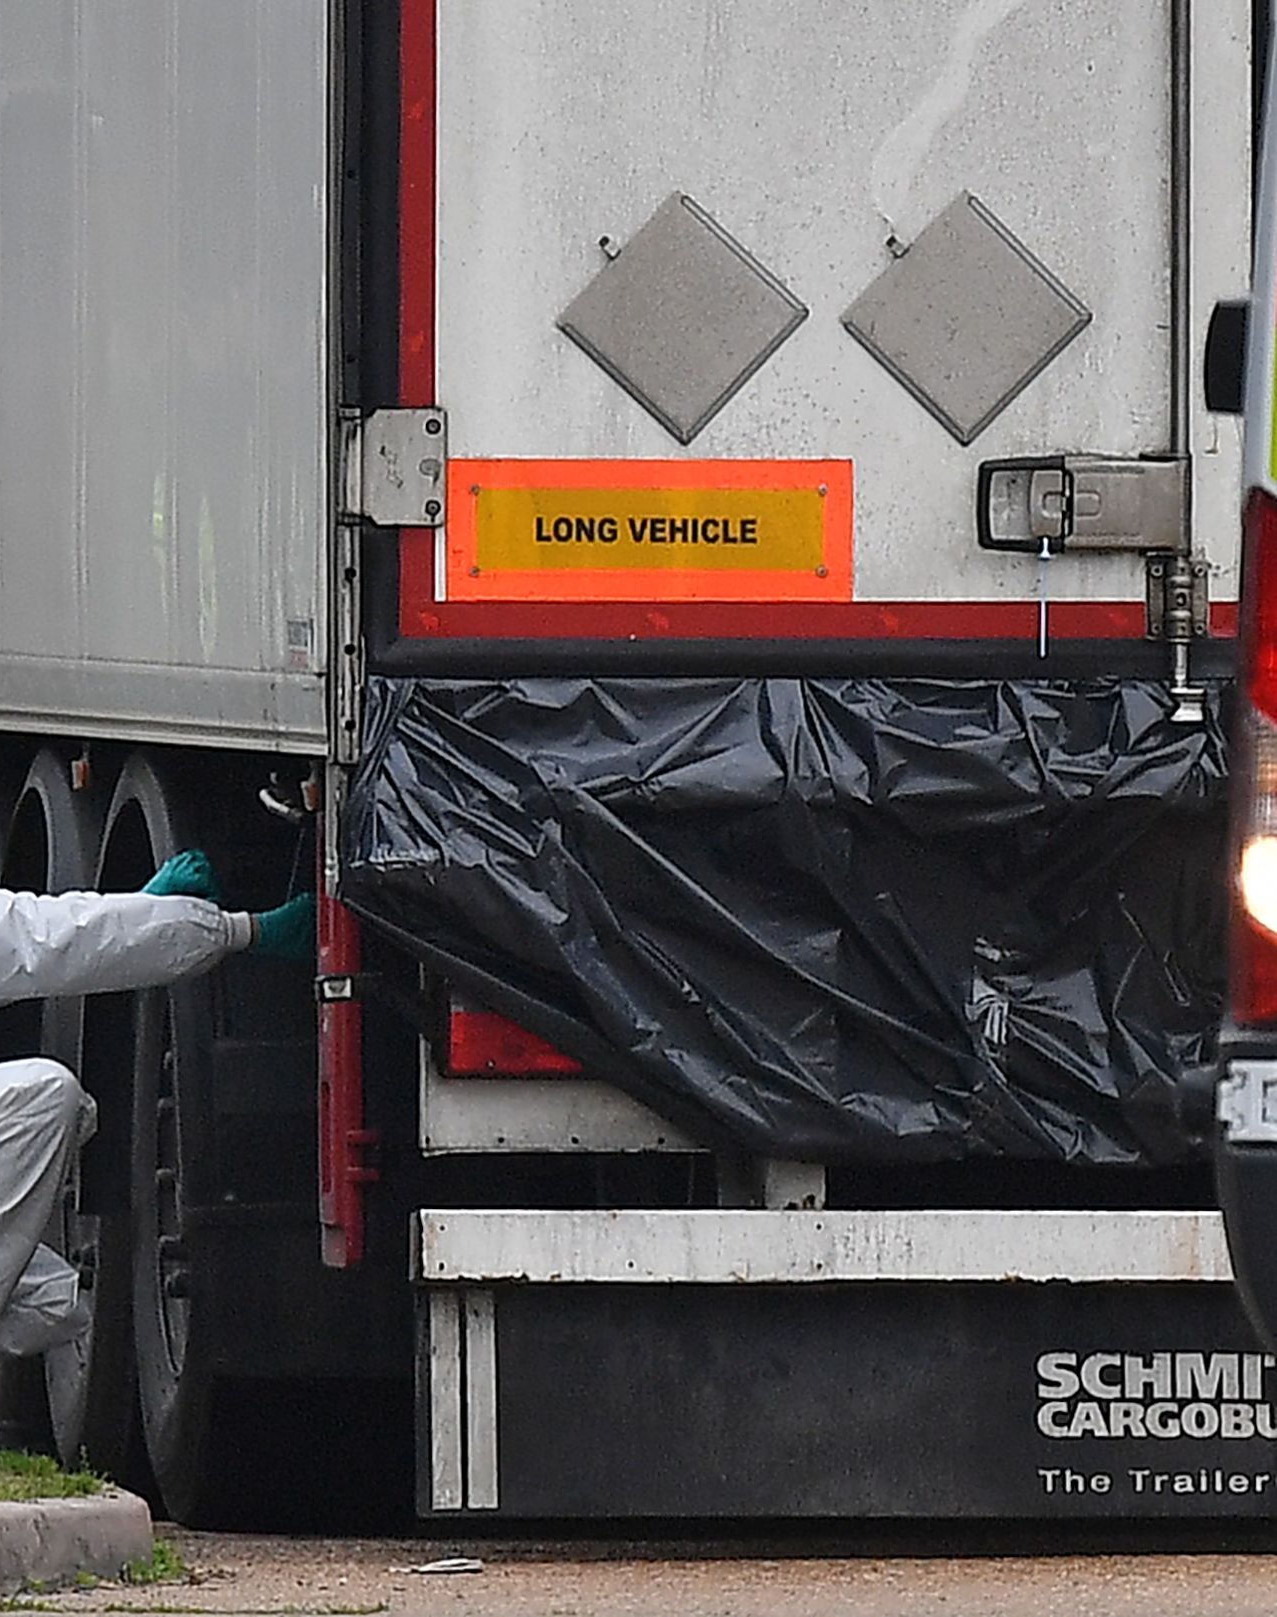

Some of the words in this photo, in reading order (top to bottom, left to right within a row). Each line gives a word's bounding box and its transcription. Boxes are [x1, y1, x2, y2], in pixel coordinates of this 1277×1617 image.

[535, 517, 618, 542] LONG
[628, 518, 757, 544] VEHICLE
[1037, 1352, 1276, 1399] SCHMI
[1038, 1469, 1111, 1493] The
[1128, 1469, 1270, 1493] Trailer
